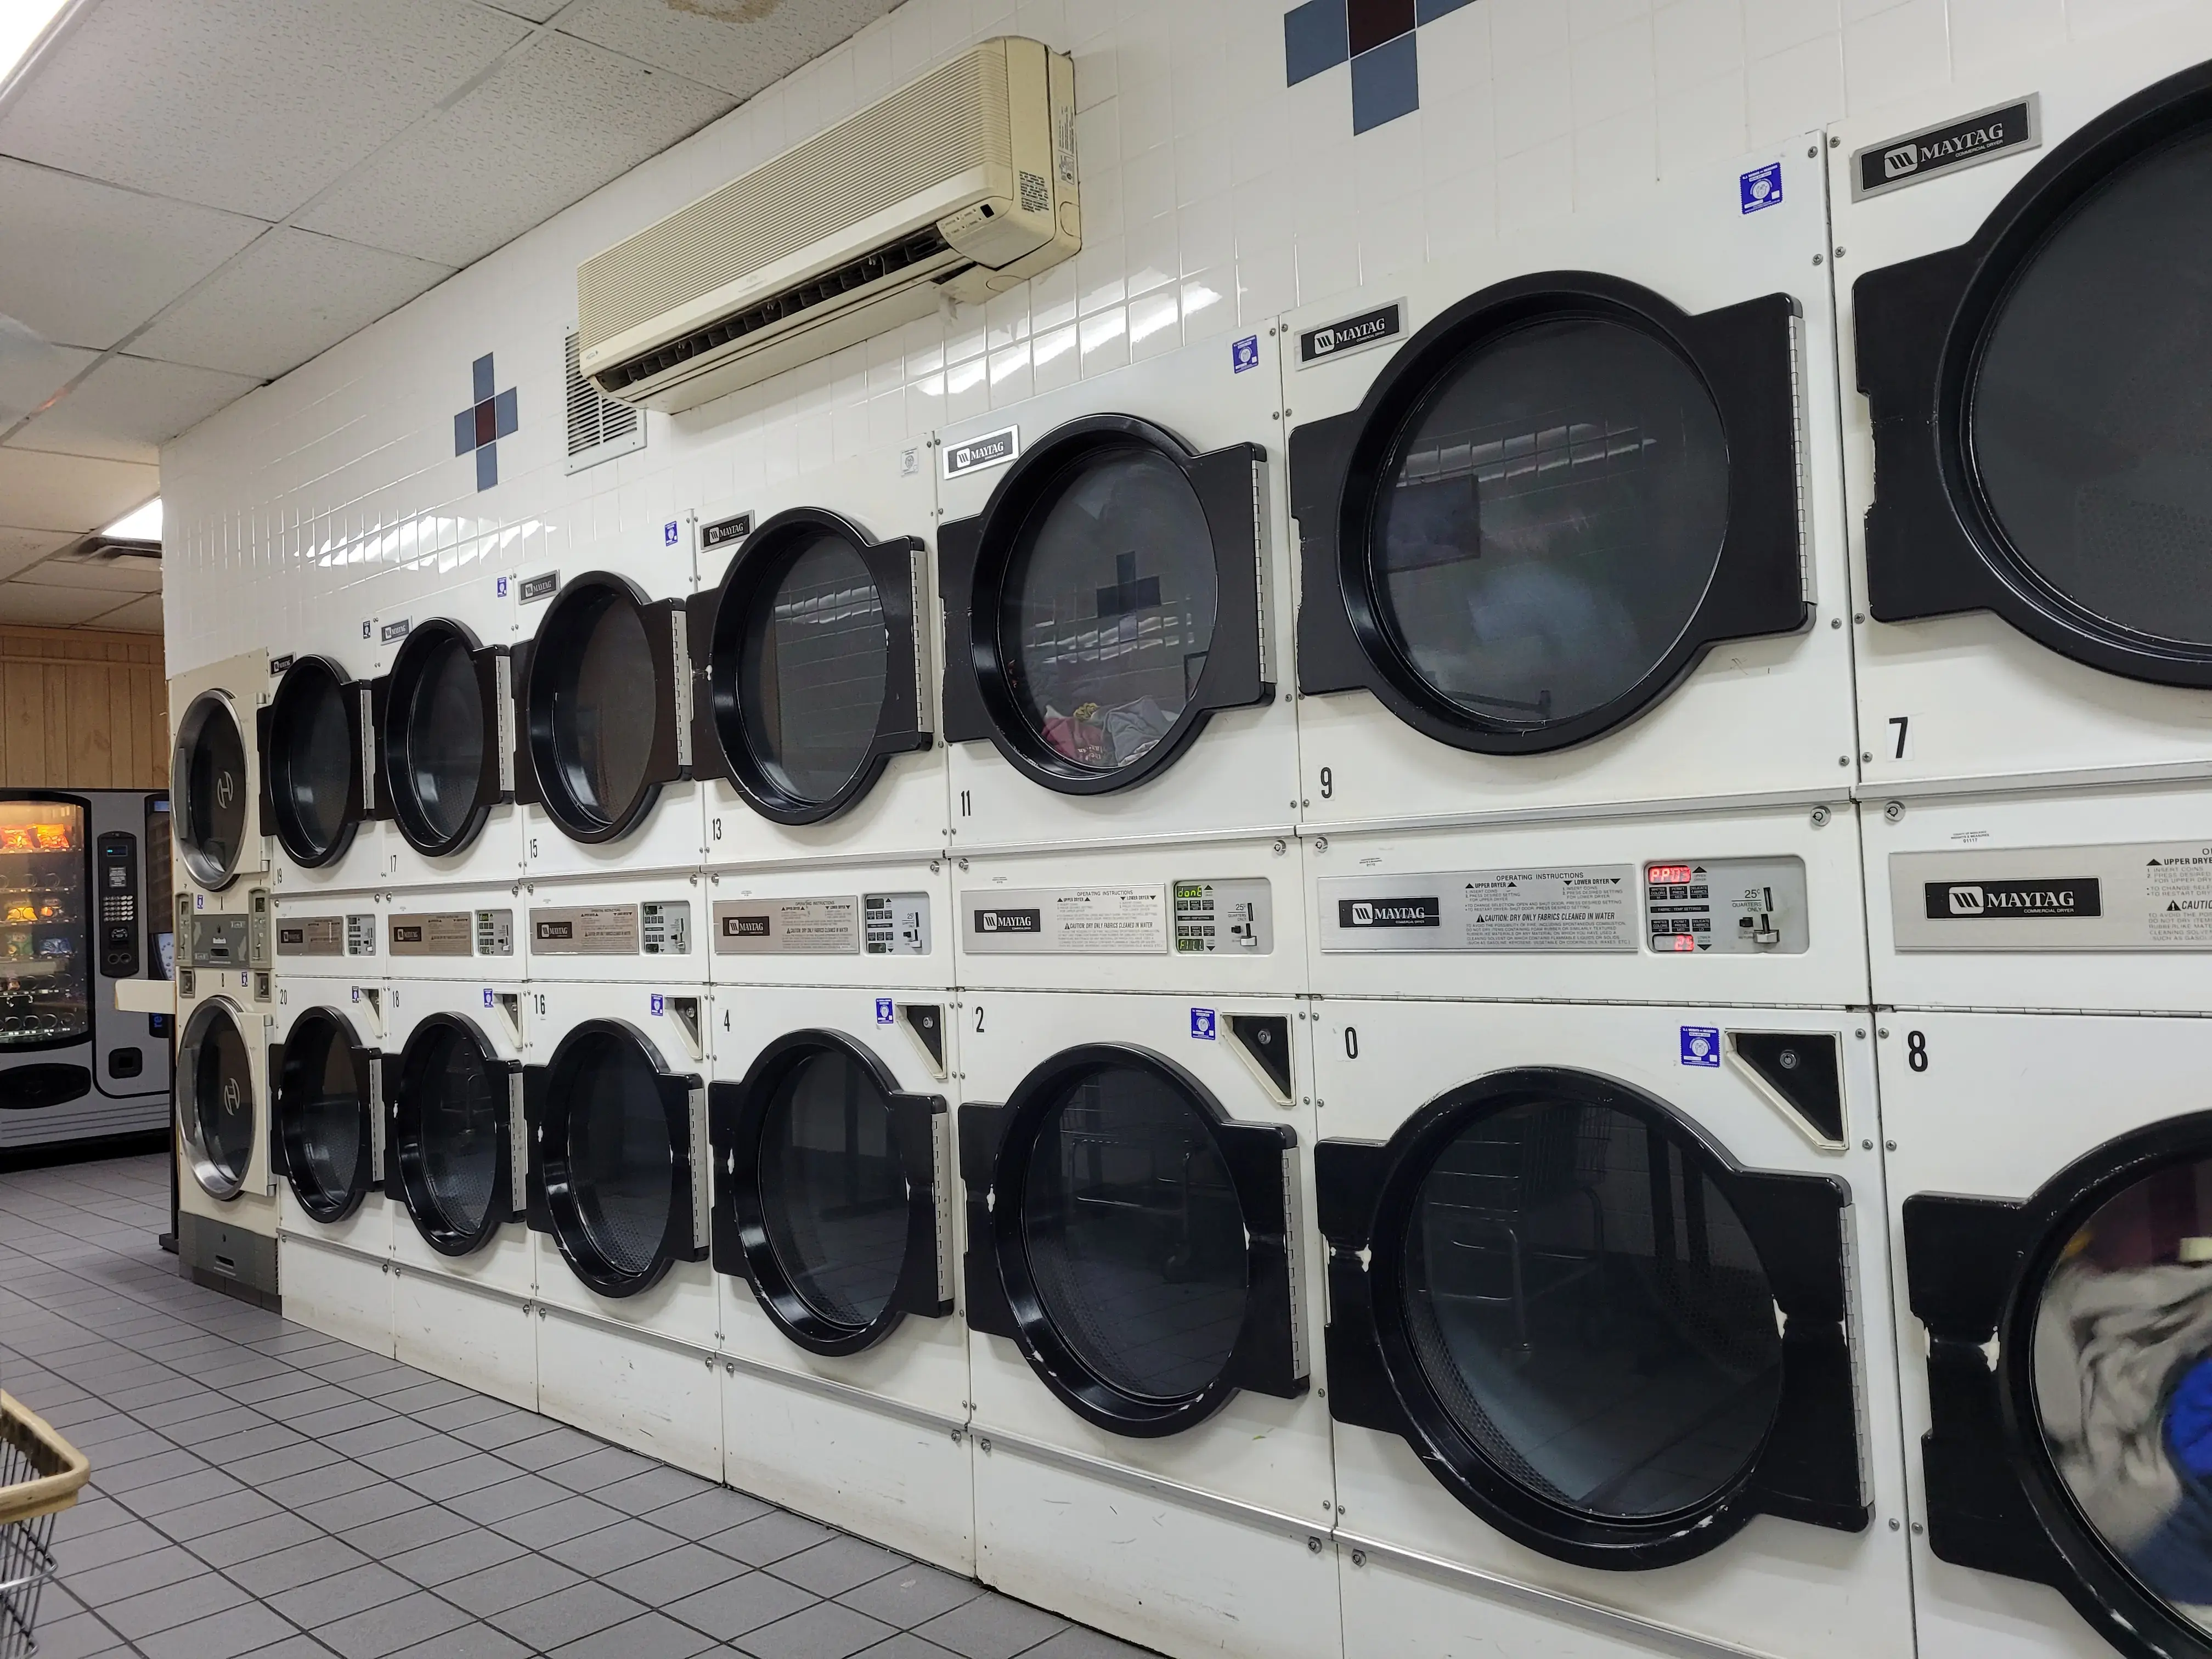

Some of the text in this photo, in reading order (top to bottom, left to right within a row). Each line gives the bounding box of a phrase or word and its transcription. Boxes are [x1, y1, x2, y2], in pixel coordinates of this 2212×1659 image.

[1920, 123, 2003, 162] MAYTAG
[1955, 145, 1985, 157] COMMERCIAL
[1336, 318, 1385, 344] MAYTAG
[971, 442, 1003, 460] MAYTAG
[720, 523, 743, 537] MAYTAG
[1889, 716, 1908, 759] 7
[1321, 766, 1333, 799] 9
[961, 790, 971, 816] 11
[713, 818, 721, 840] 13
[530, 839, 537, 858] 15
[391, 855, 396, 872] 17
[277, 868, 282, 884] 19
[1987, 891, 2074, 907] MAYTAG
[998, 917, 1031, 926] MAYTAG
[1374, 907, 1425, 919] MAYTAG
[740, 923, 763, 931] MAYTAG
[280, 989, 287, 1005] 20
[393, 990, 399, 1008] 18
[534, 994, 545, 1015] 16
[724, 1009, 730, 1031] 4
[975, 1006, 984, 1033] 2
[1345, 1026, 1358, 1059] 0
[1908, 1030, 1928, 1072] 8
